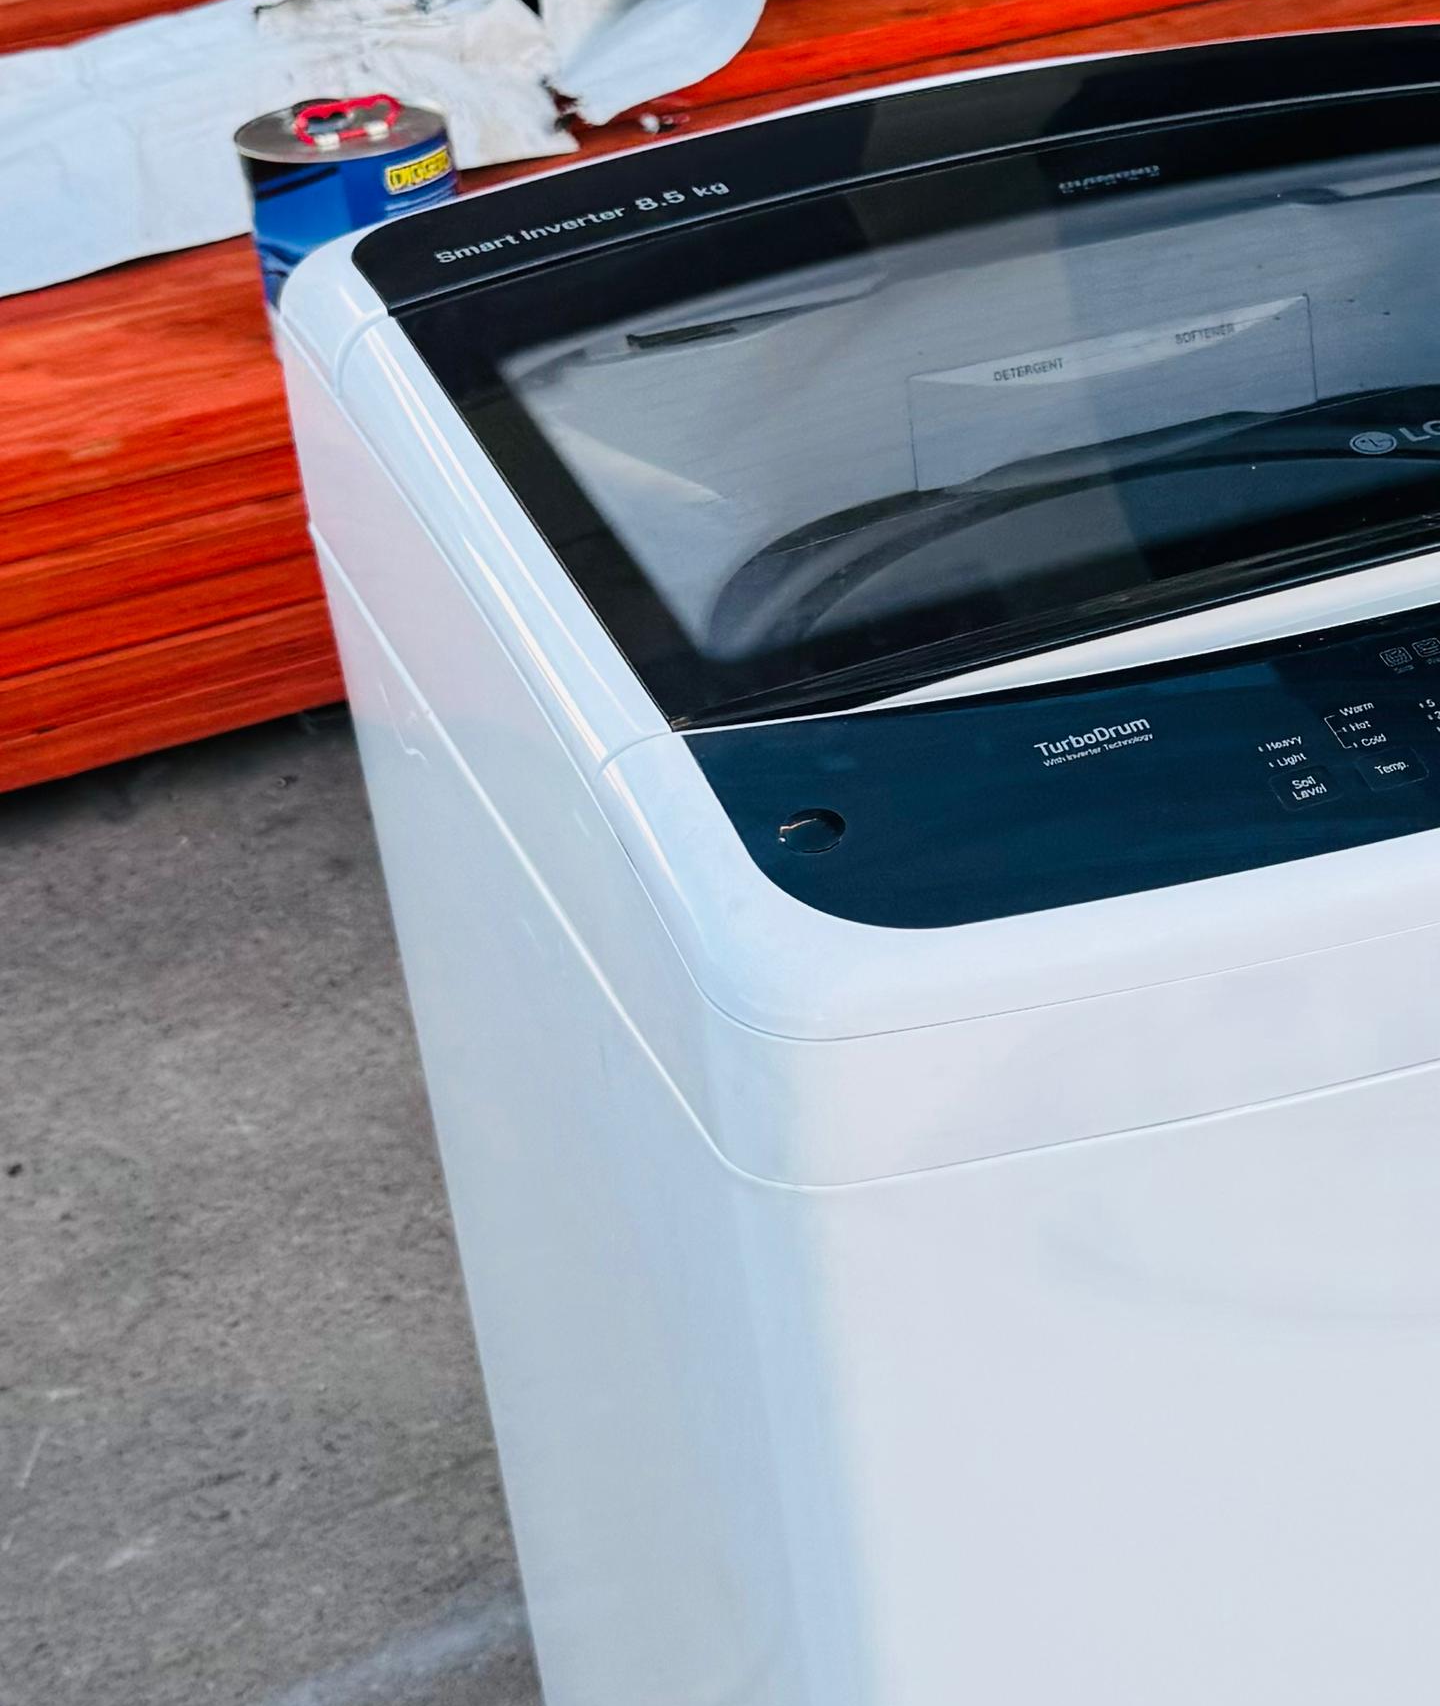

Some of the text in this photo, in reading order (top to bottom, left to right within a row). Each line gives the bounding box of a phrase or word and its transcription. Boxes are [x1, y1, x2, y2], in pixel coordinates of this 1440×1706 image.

[436, 180, 729, 263] Smart Inverter 8.5 kg
[1175, 322, 1235, 345] SOFTENER
[993, 357, 1064, 382] DETERGENT
[1339, 701, 1375, 717] Warm
[1425, 698, 1436, 708] 5
[1349, 720, 1372, 731] Hot
[1033, 717, 1151, 757] TurboDrum
[1266, 735, 1302, 751] Heavy
[1361, 733, 1387, 747] Cold
[1043, 733, 1153, 768] With Inverter Technology
[1276, 752, 1307, 767] Light
[1374, 760, 1409, 775] Temp.
[1291, 775, 1317, 790] Soil
[1292, 783, 1328, 801] Level
